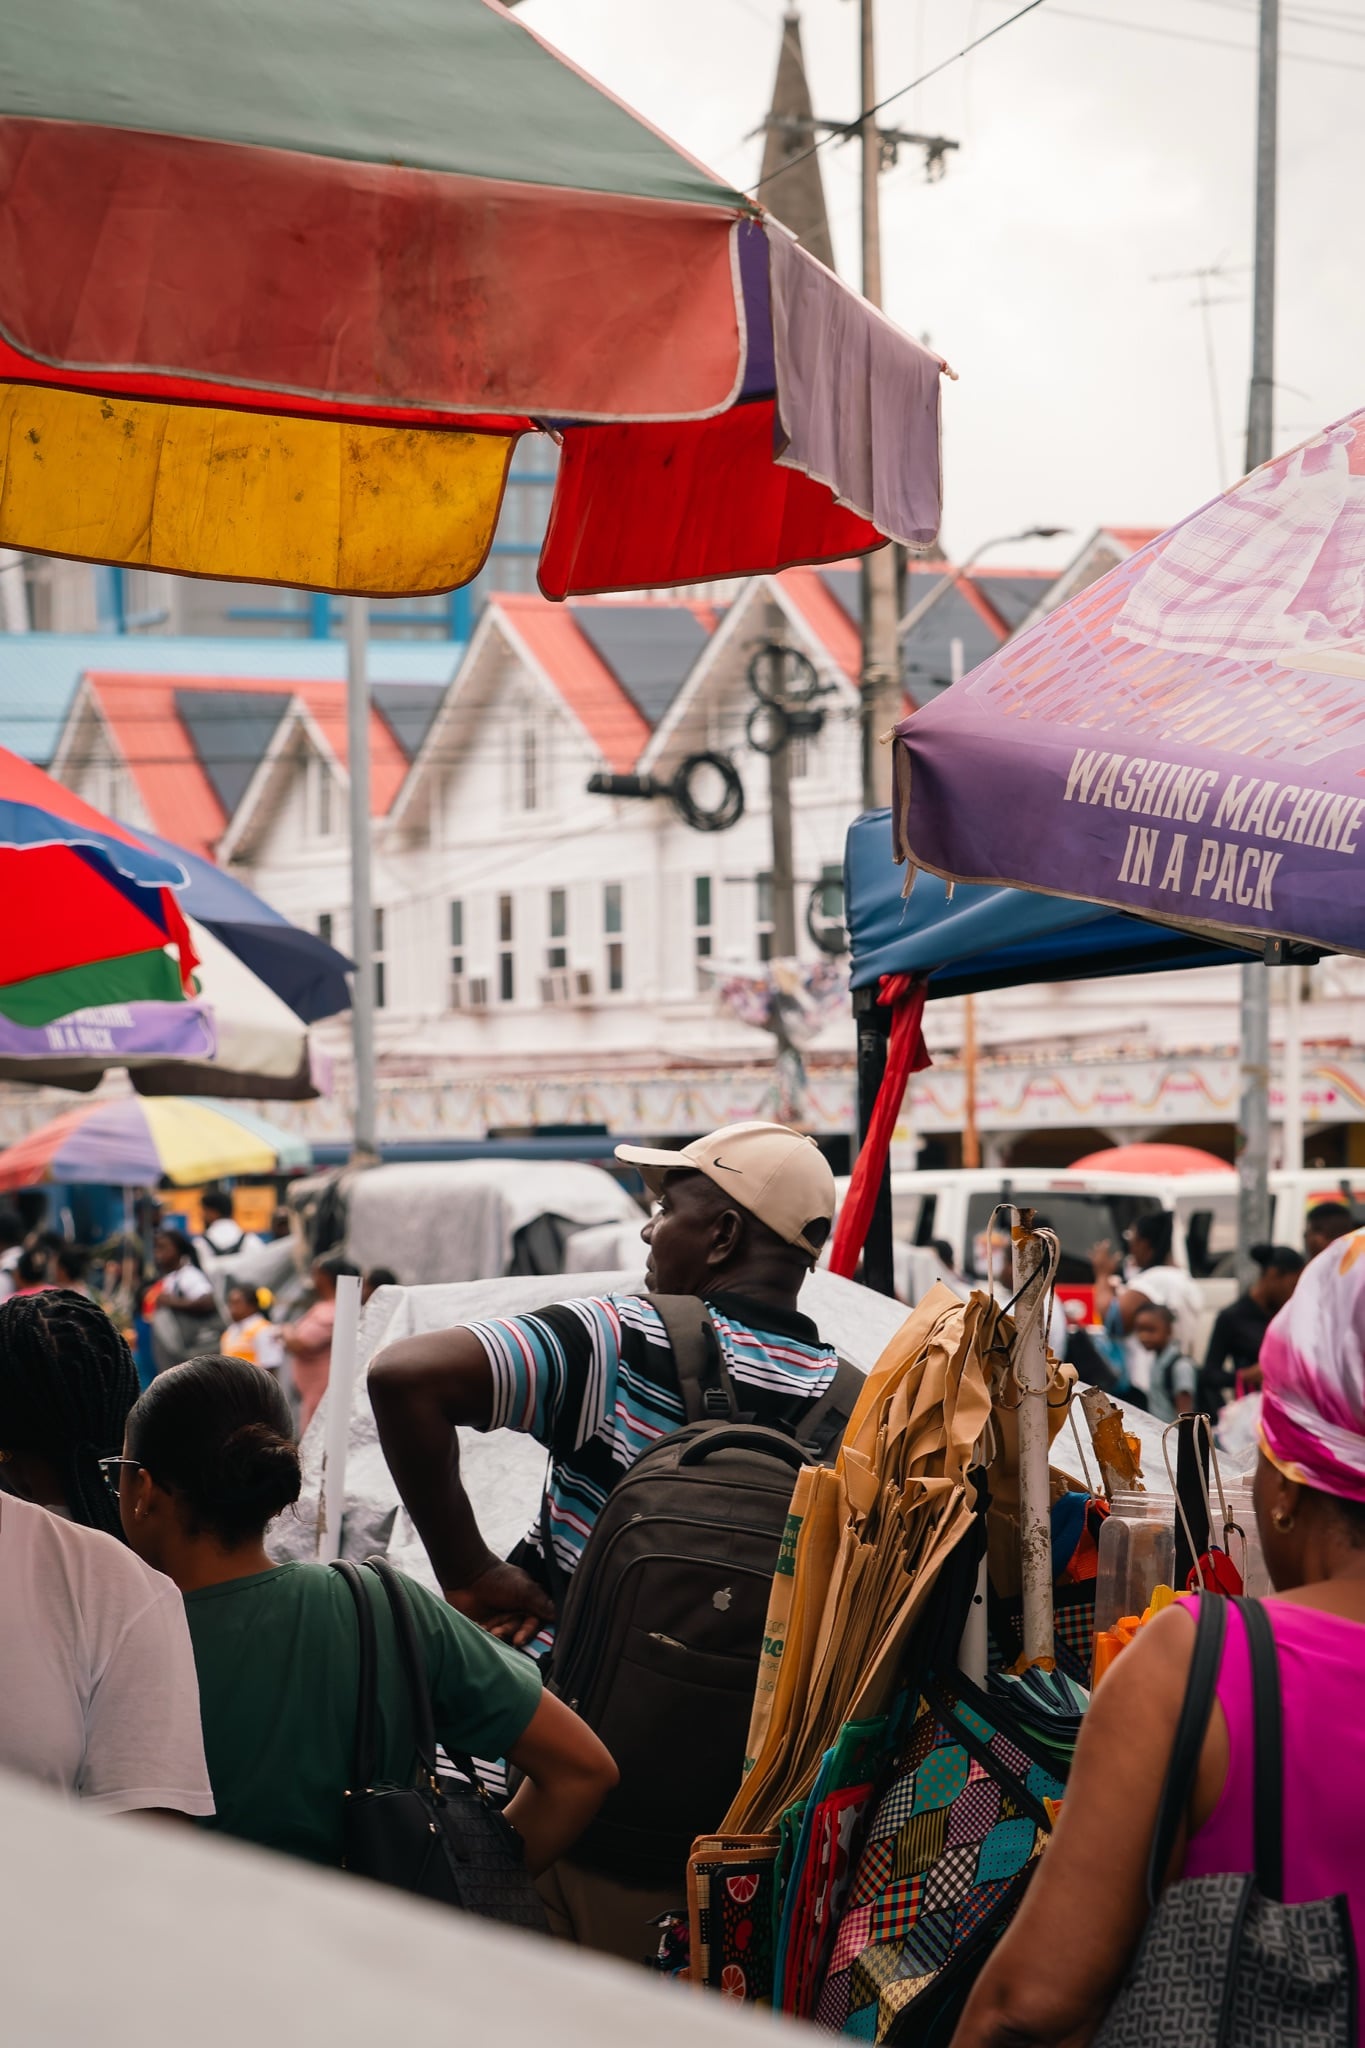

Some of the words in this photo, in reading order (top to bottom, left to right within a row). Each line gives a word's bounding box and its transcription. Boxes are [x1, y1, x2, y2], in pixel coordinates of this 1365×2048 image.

[1063, 747, 1219, 822] WASHING
[1211, 774, 1365, 854] MACHINE
[1117, 825, 1159, 886] IN
[1159, 833, 1188, 892] A
[1191, 838, 1284, 911] PACK
